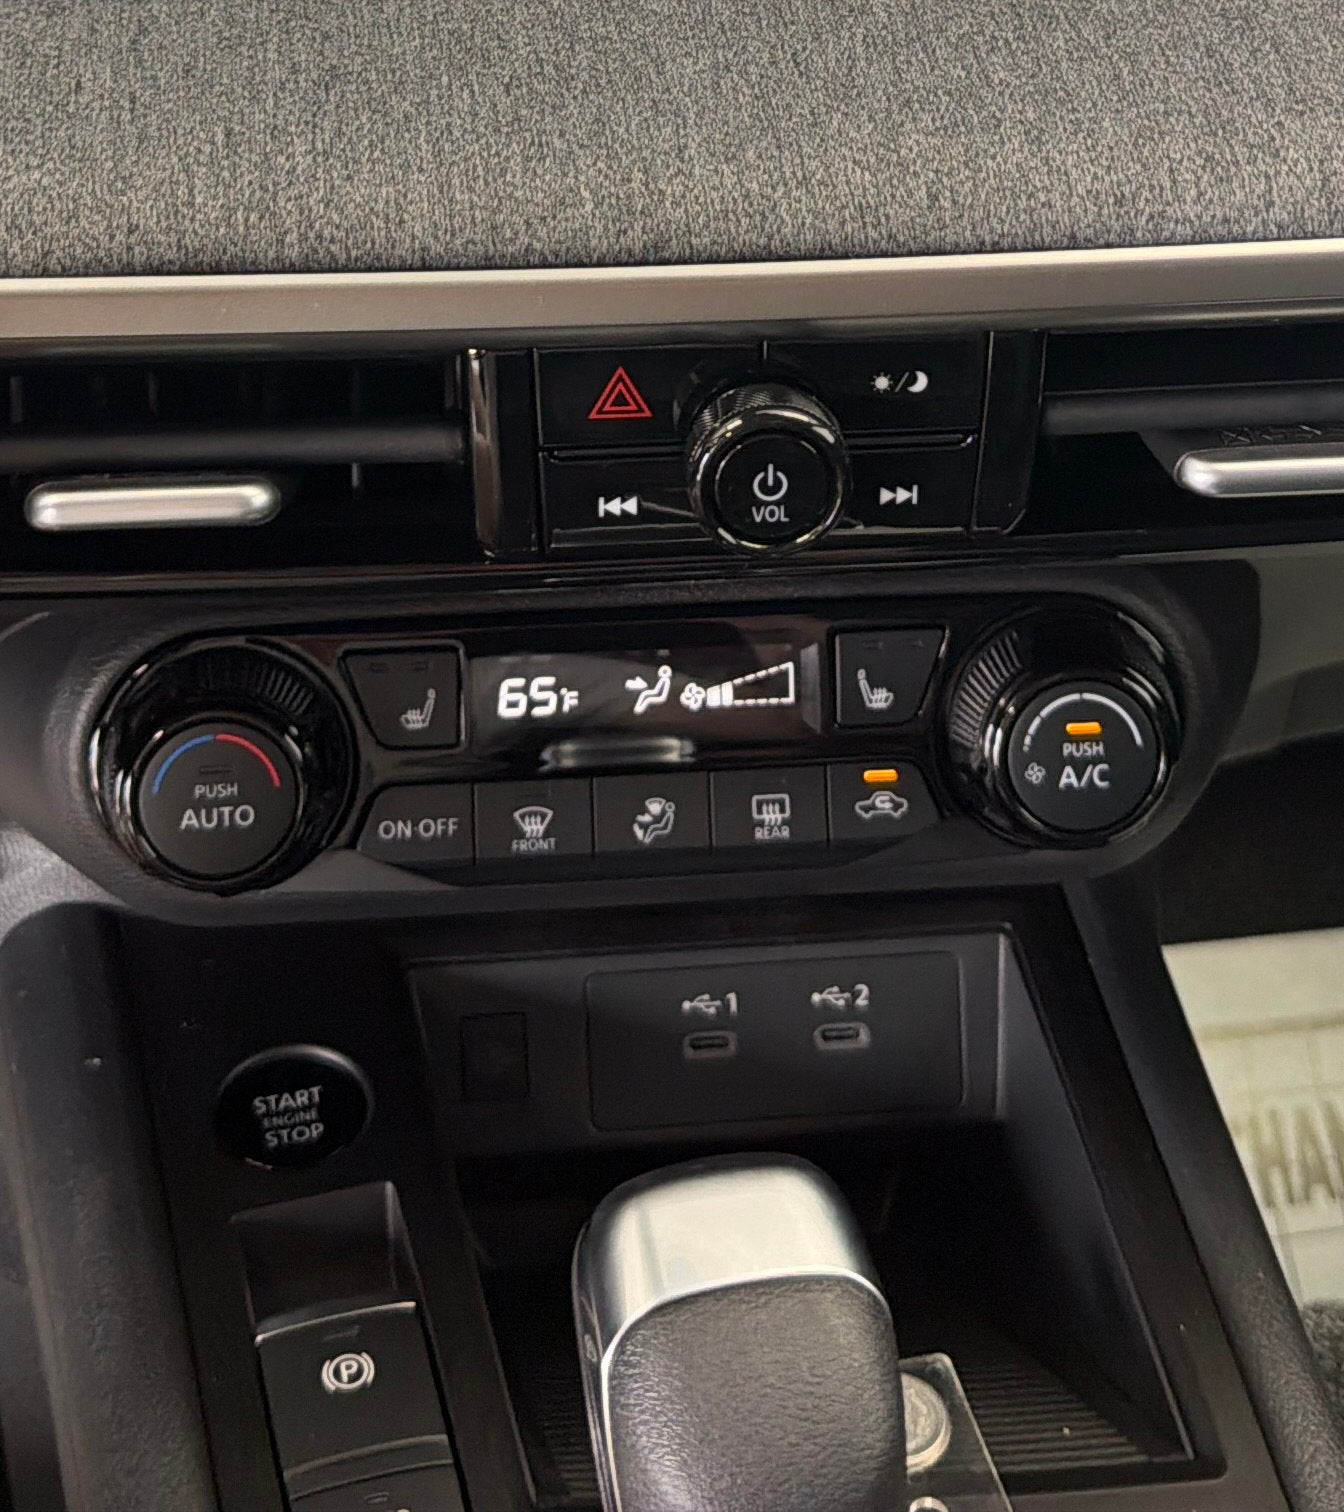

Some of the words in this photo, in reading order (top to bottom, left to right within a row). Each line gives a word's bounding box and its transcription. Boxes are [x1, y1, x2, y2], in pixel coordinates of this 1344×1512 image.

[751, 505, 790, 524] VOL
[1061, 740, 1105, 758] PUSH
[1058, 763, 1111, 789] A/C
[194, 782, 239, 800] PUSH
[179, 804, 256, 830] AUTO
[754, 824, 792, 840] REAR
[512, 837, 557, 853] FRONT
[853, 983, 871, 1007] 2
[252, 1084, 323, 1114] START
[262, 1108, 319, 1129] ENGINE
[264, 1122, 325, 1149] STOP
